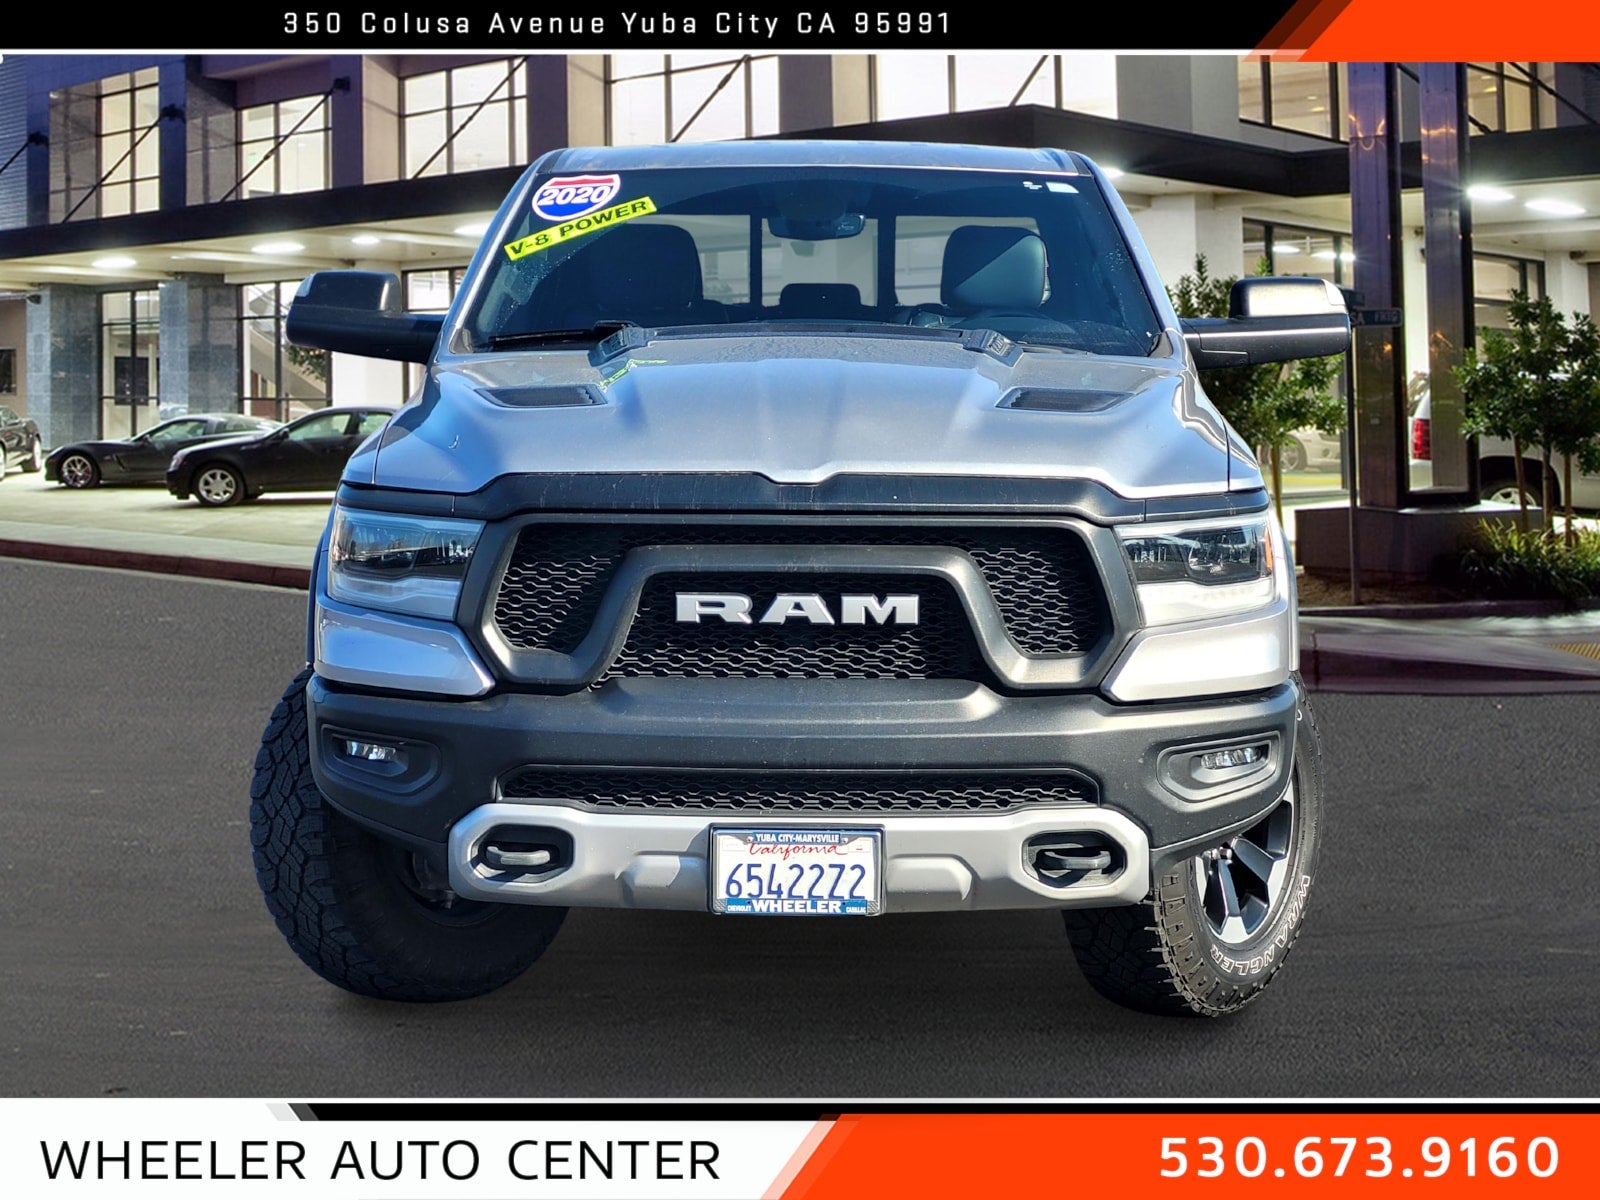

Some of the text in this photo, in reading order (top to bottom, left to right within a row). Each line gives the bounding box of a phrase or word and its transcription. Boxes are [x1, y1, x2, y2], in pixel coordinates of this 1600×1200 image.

[537, 185, 611, 206] 2020
[510, 201, 647, 255] V-8 POWER
[675, 592, 919, 624] RAM
[755, 833, 840, 843] YUBA CITY-MARYSVILLE
[749, 842, 848, 860] California
[753, 899, 841, 913] WHEELER
[1210, 875, 1311, 976] WRANGLER
